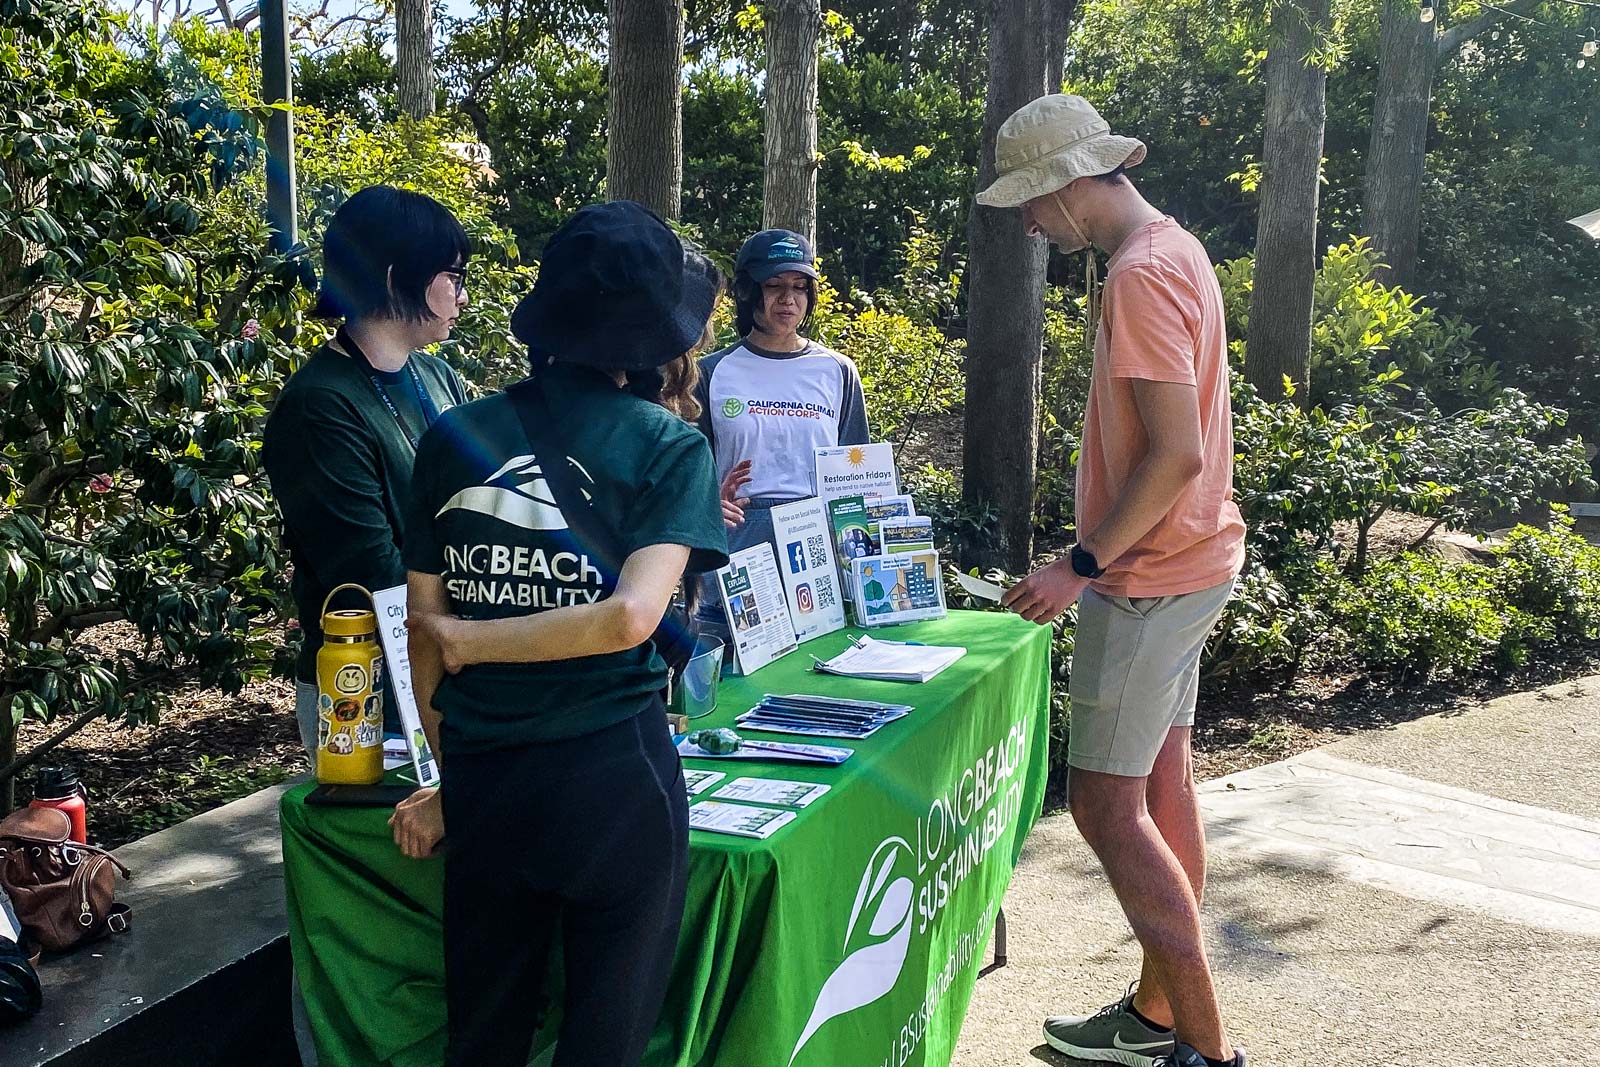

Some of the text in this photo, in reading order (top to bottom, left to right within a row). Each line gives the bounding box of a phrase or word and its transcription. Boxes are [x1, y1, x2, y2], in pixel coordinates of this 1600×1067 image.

[747, 399, 837, 419] CALIFORNIA CLIMAT
[748, 406, 820, 420] ACTION CORPS
[823, 470, 892, 484] Restoration Fridays
[727, 575, 747, 589] EXPLORE
[387, 605, 404, 619] City
[917, 714, 1027, 876] LONGBEACH
[918, 774, 1023, 935] SUSTAINABILITY
